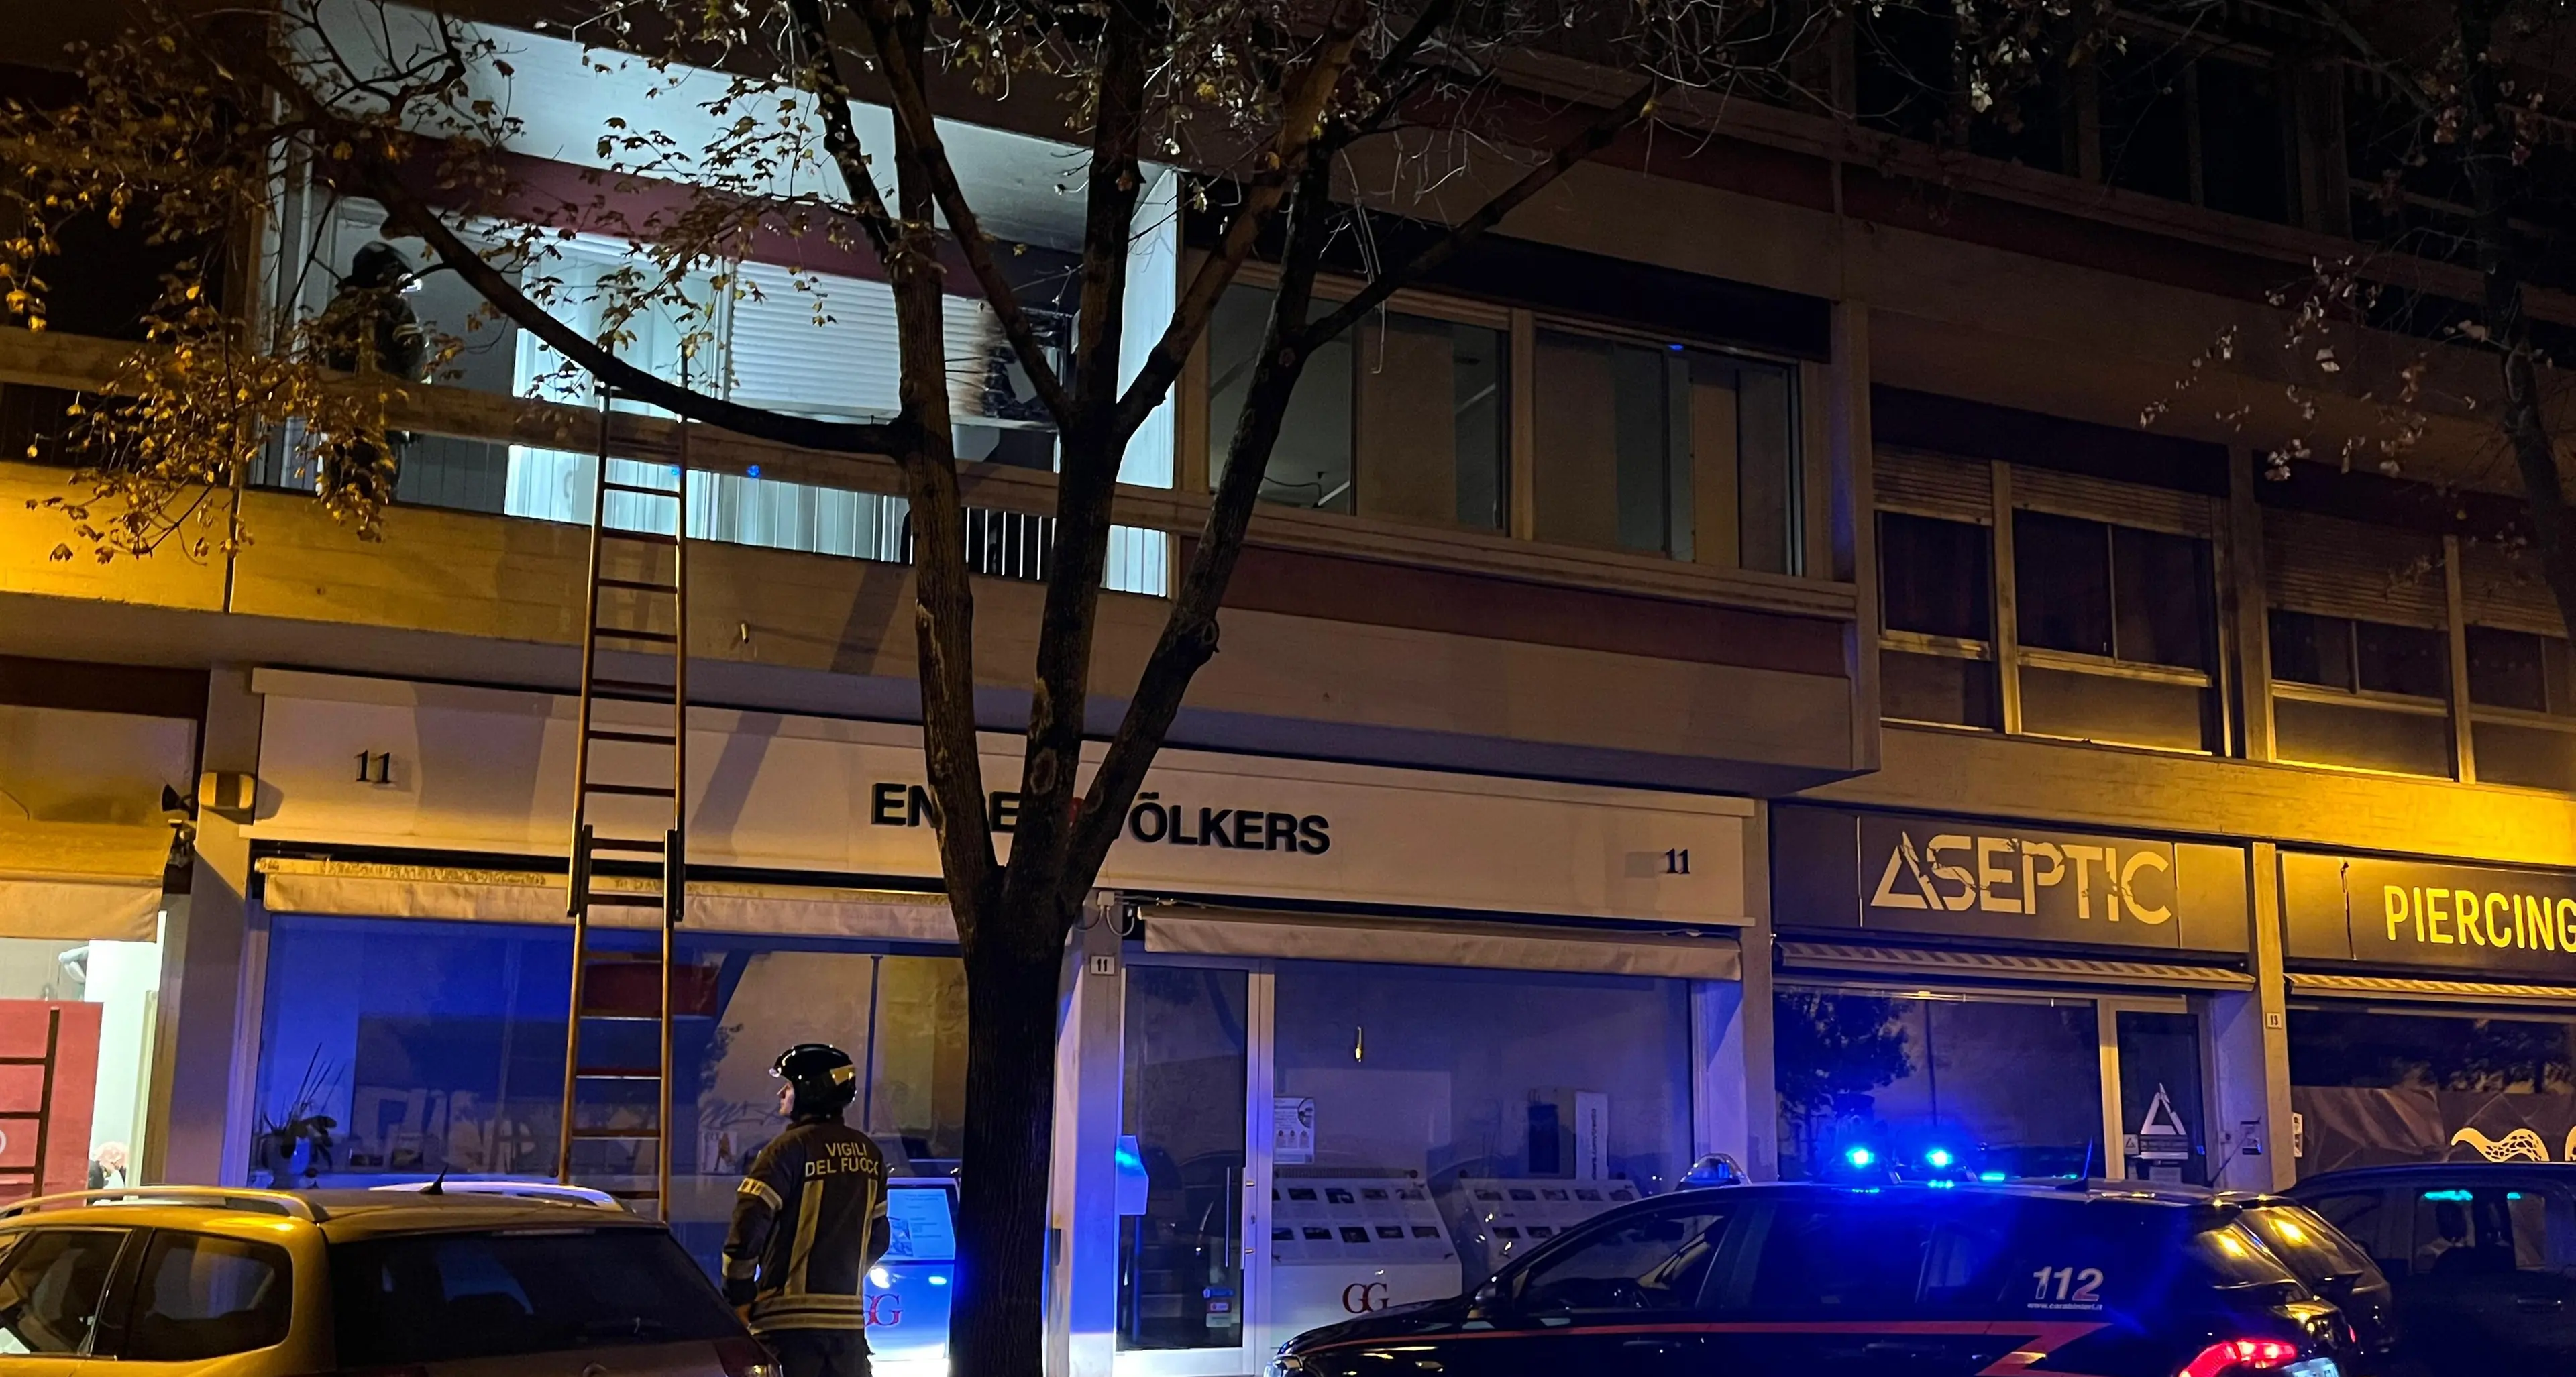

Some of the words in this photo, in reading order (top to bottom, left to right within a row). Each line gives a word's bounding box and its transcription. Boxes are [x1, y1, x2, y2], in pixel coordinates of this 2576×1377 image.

[353, 749, 392, 784] 11
[871, 782, 1021, 833] ENE
[1129, 791, 1331, 855] ÖLKERS
[1665, 848, 1690, 875] 11
[1870, 830, 2171, 924] ASEPTIC
[2383, 885, 2576, 953] PIERCING
[1097, 958, 1108, 972] 11
[2270, 1014, 2278, 1026] 13
[825, 1142, 867, 1157] VIGILI
[805, 1159, 837, 1178] DEL
[2033, 1266, 2104, 1302] 112
